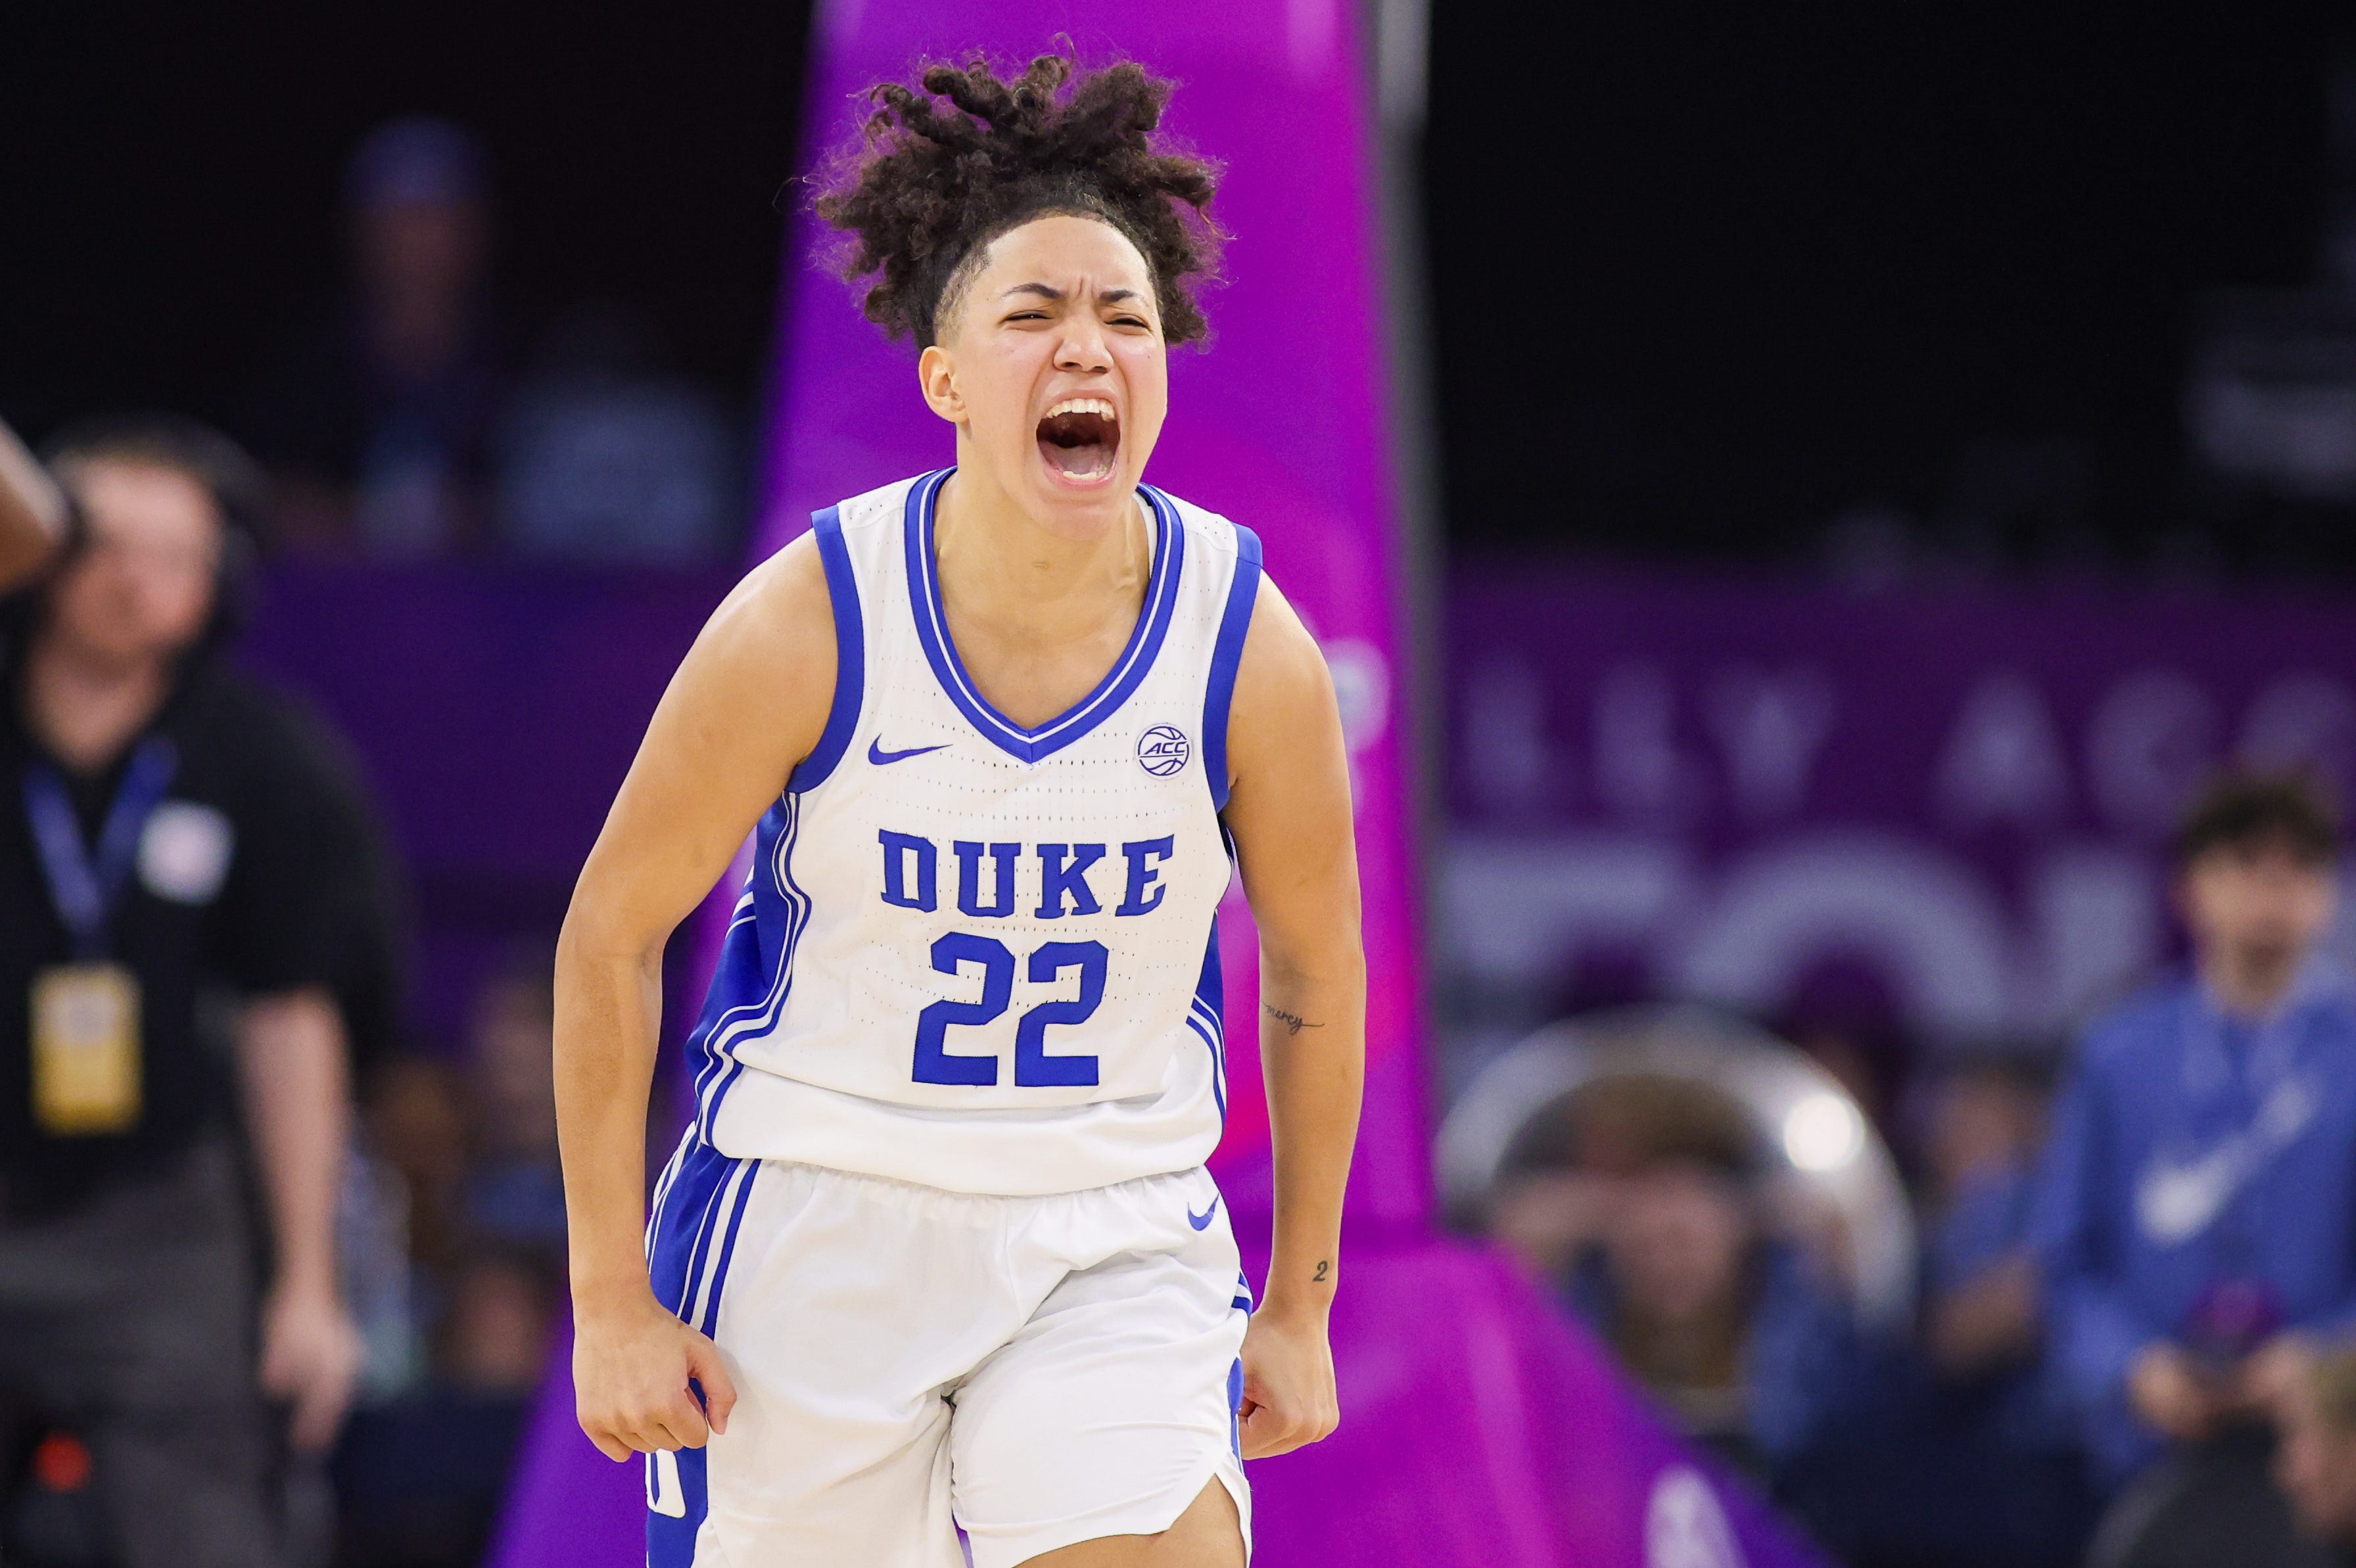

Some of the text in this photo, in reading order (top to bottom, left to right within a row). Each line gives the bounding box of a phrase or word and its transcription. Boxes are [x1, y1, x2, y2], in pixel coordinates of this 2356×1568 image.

[1143, 741, 1187, 754] ACC
[878, 829, 1175, 919] DUKE
[912, 931, 1109, 1087] 22
[1312, 1260, 1328, 1282] 2
